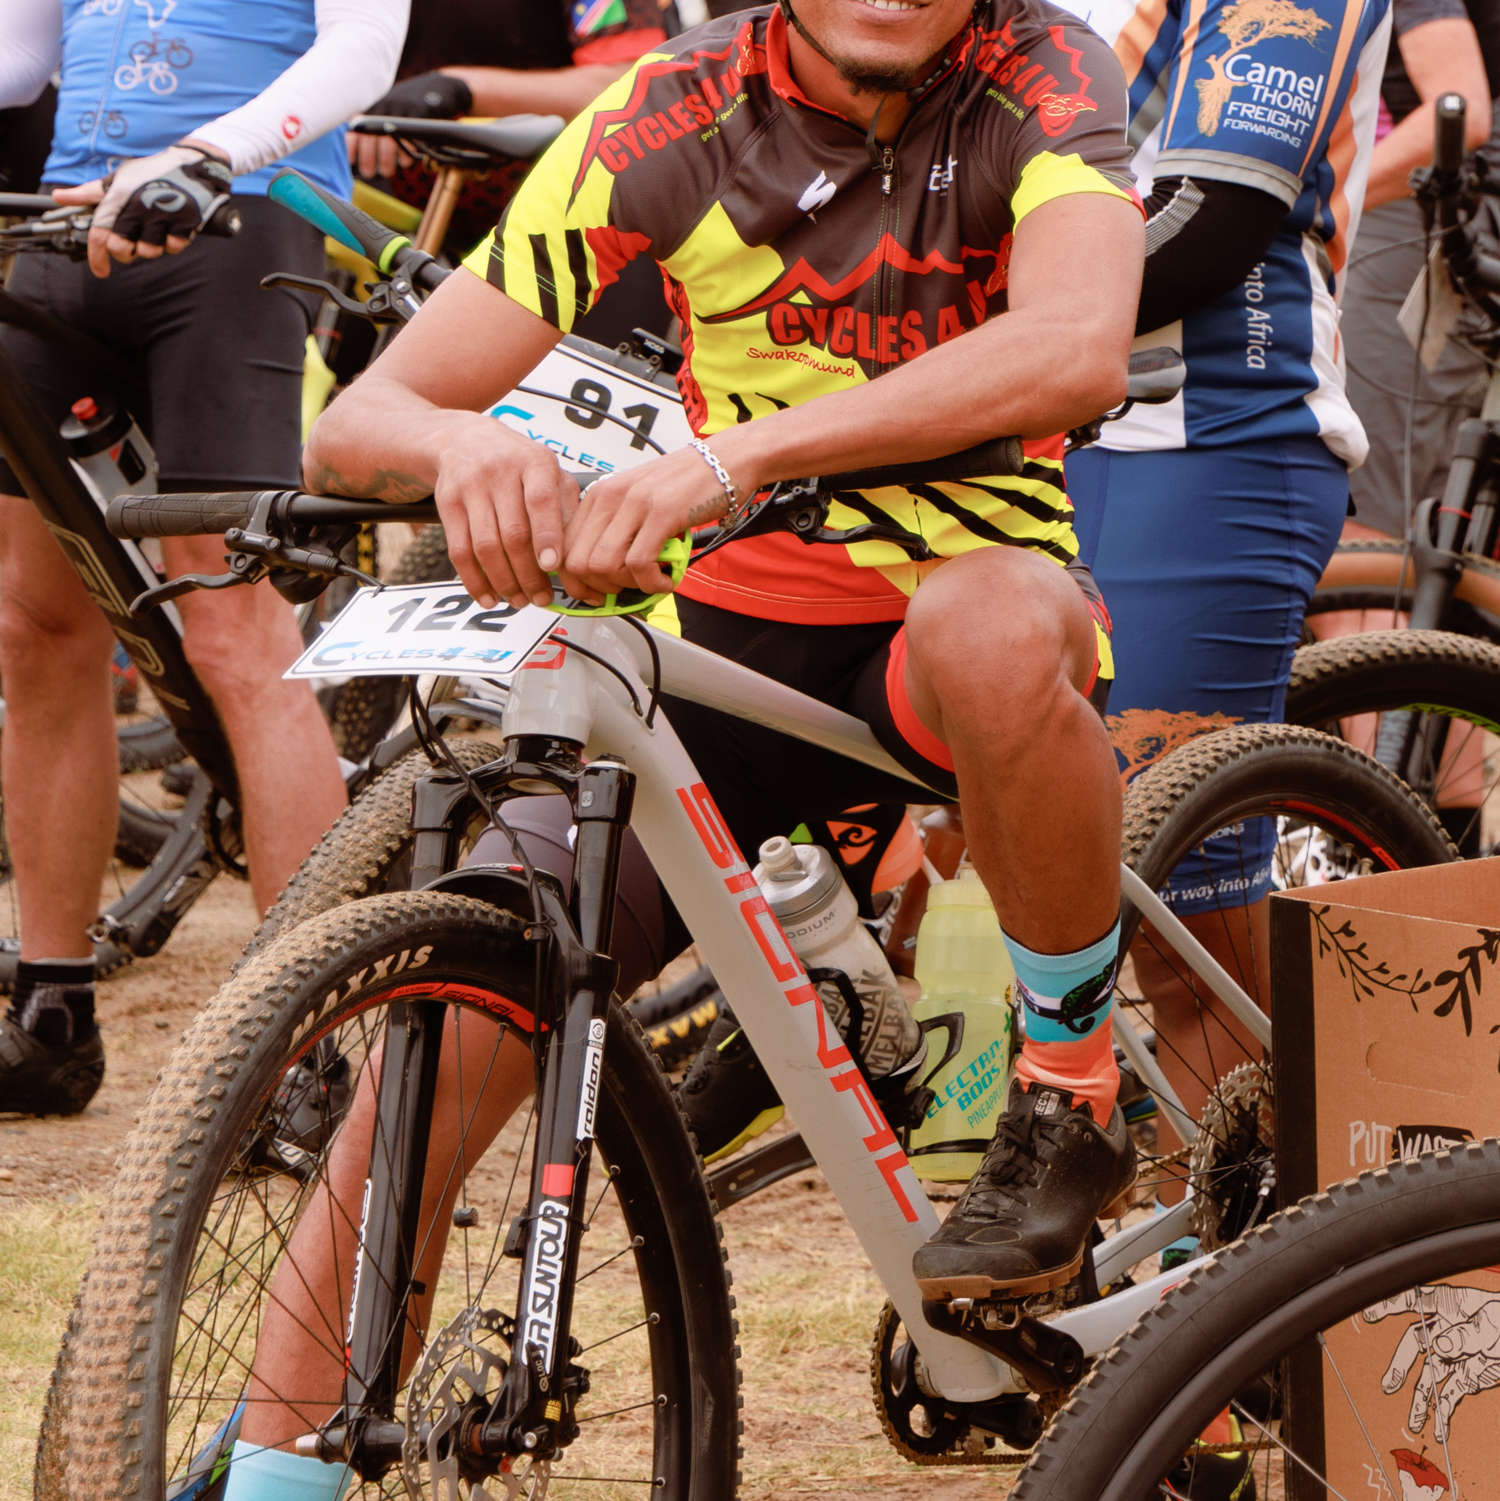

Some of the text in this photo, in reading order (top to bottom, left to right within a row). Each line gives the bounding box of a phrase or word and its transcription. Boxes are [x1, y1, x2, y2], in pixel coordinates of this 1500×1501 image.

[1012, 63, 1045, 95] 4
[1225, 54, 1325, 103] Camel
[1227, 101, 1310, 136] FREIGHT
[1251, 84, 1317, 121] THORN
[598, 94, 714, 172] CYCLES
[701, 77, 723, 110] 4
[1223, 118, 1302, 149] FORWARDING
[770, 302, 928, 365] CYCLES
[1245, 306, 1274, 369] Africa
[746, 347, 855, 379] Swakopmund
[564, 378, 660, 451] 91
[385, 593, 522, 634] 122
[1181, 884, 1215, 900] way
[1218, 877, 1250, 893] into
[786, 911, 836, 940] ODIUM
[1349, 1119, 1391, 1167] PUT
[530, 1202, 568, 1320] SUNTOUR
